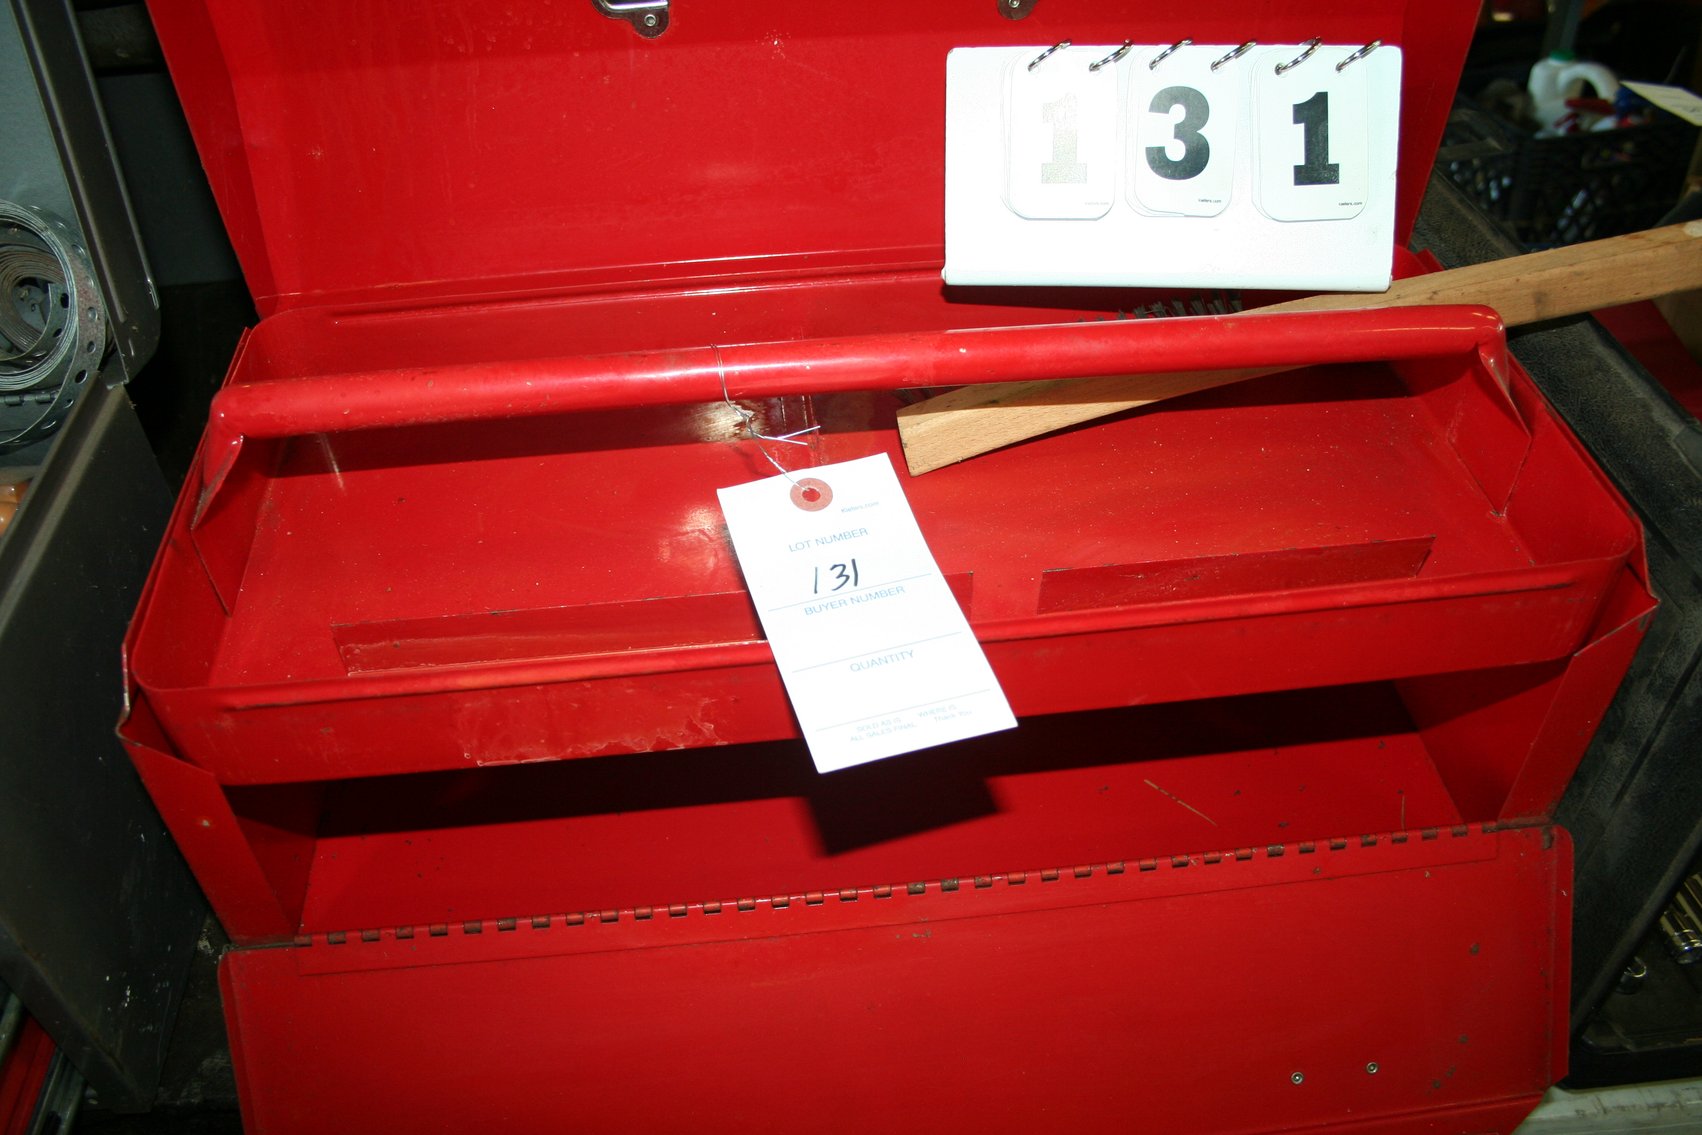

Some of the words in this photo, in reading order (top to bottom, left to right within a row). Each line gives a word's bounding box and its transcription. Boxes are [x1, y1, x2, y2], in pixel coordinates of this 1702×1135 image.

[788, 539, 811, 552] LOT
[815, 527, 869, 546] NUMBER
[813, 558, 859, 594] 131
[804, 598, 848, 615] BUYER
[850, 585, 905, 604] NUMBER
[850, 649, 914, 672] QUANTITY
